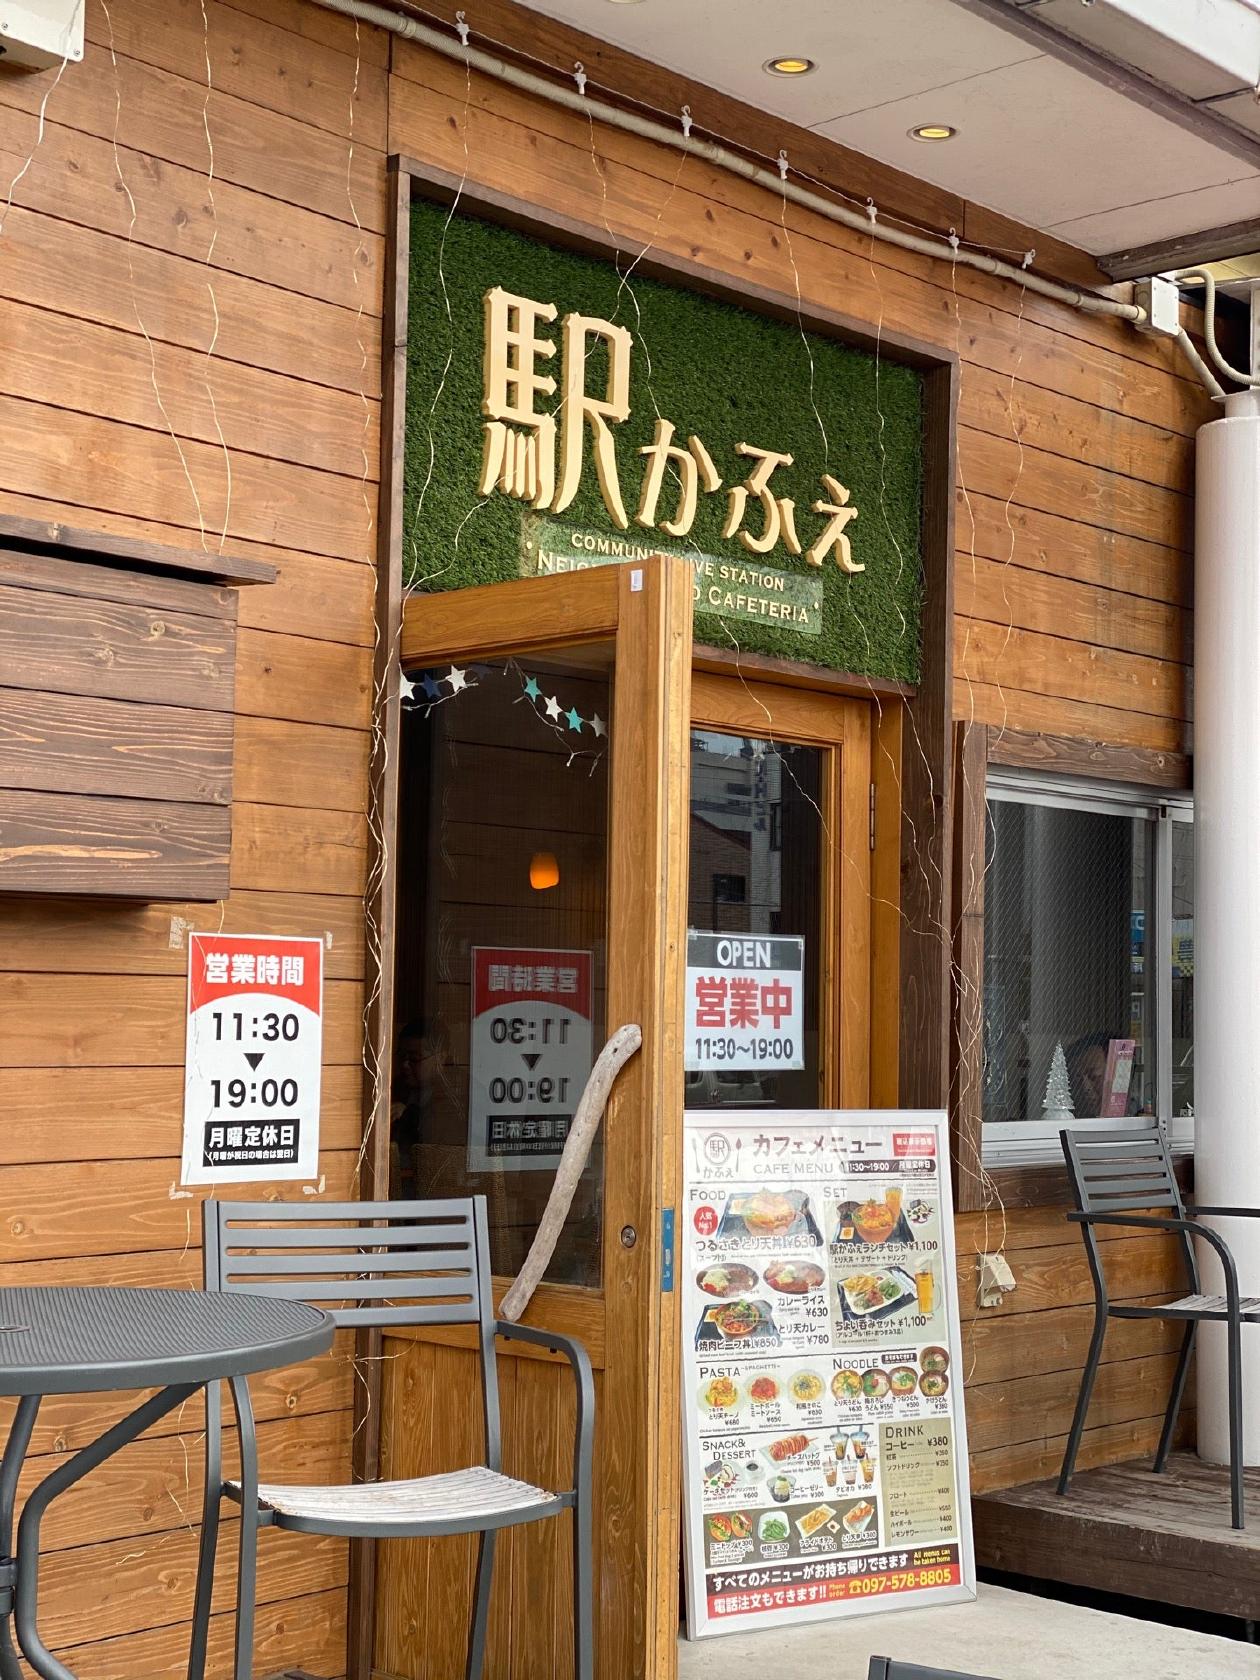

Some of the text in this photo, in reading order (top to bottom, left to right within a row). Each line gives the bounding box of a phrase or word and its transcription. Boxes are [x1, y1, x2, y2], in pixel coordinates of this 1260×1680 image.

[719, 565, 785, 592] STATION
[708, 585, 809, 623] CAFETERIA
[716, 939, 771, 968] OPEN
[205, 953, 305, 986] 営業時間
[695, 975, 792, 1029] 営業中
[212, 1012, 300, 1041] 11:30
[210, 1078, 299, 1108] 19:00
[209, 1125, 294, 1148] 月曜定休日
[753, 1134, 882, 1157] カフェメニュー
[753, 1163, 833, 1174] CAFE MENU
[690, 1189, 726, 1200] FOOD
[823, 1187, 847, 1198] SET
[908, 1240, 938, 1252] ¥1,100
[778, 1296, 825, 1307] カレーライス
[805, 1307, 828, 1317] ¥630
[779, 1322, 825, 1334] とり天カレー
[898, 1316, 926, 1328] ¥1,100
[807, 1334, 829, 1345] ¥780
[833, 1358, 879, 1370] NOODLE
[700, 1366, 740, 1379] PASTA
[885, 1425, 924, 1439] DRINK
[702, 1439, 746, 1451] SNACK&
[885, 1440, 915, 1451] コーヒー
[927, 1436, 949, 1447] ¥380
[713, 1450, 756, 1461] DESSERT
[713, 1553, 908, 1592] すべてのメニューがお持ち帰りできます
[862, 1568, 952, 1594] 097-578-8805
